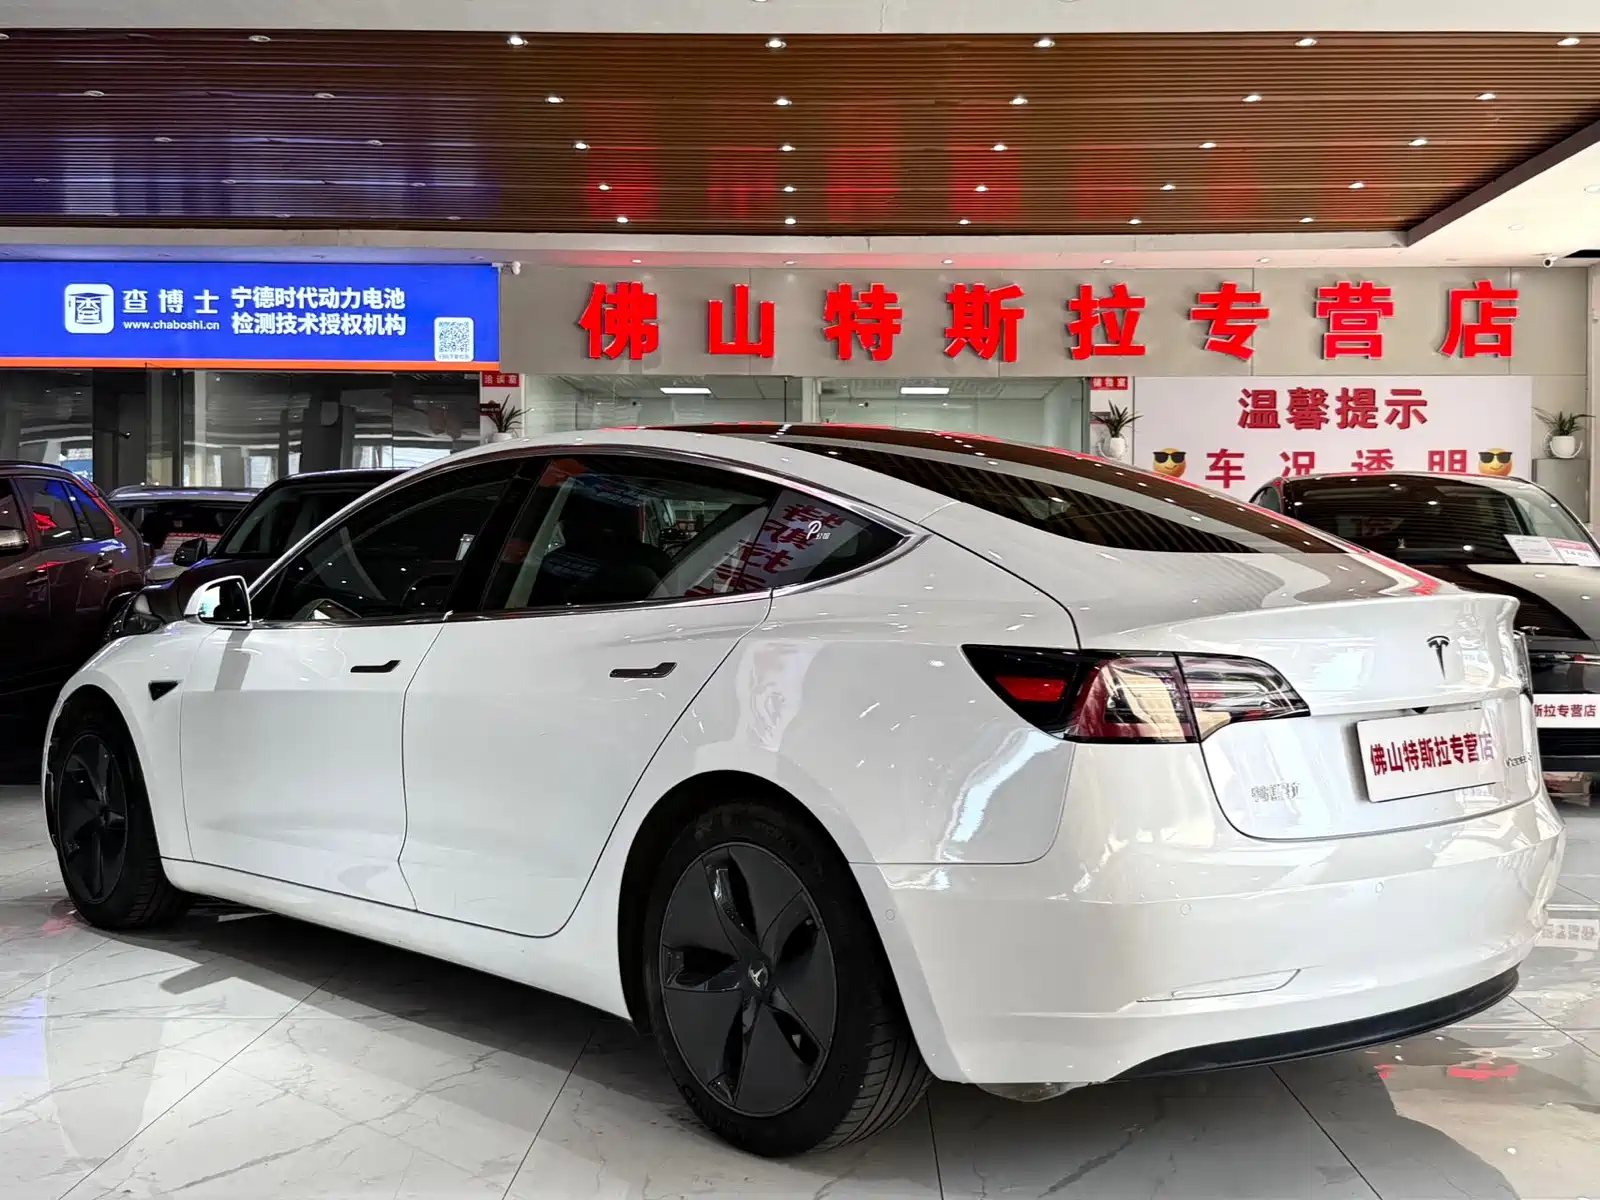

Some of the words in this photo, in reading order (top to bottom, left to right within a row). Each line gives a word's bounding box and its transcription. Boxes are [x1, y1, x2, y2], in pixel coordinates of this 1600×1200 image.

[121, 288, 221, 314] 查博士
[230, 285, 406, 310] 宁德时代动力电池
[123, 319, 220, 331] www.chaboshi.cn
[230, 311, 406, 336] 检测技术授权机构
[579, 281, 1519, 362] 佛山特斯拉专营店
[1238, 387, 1428, 430] 温馨提示
[1204, 448, 1468, 489] 车况透明
[1370, 731, 1494, 776] 佛山特斯拉专营店
